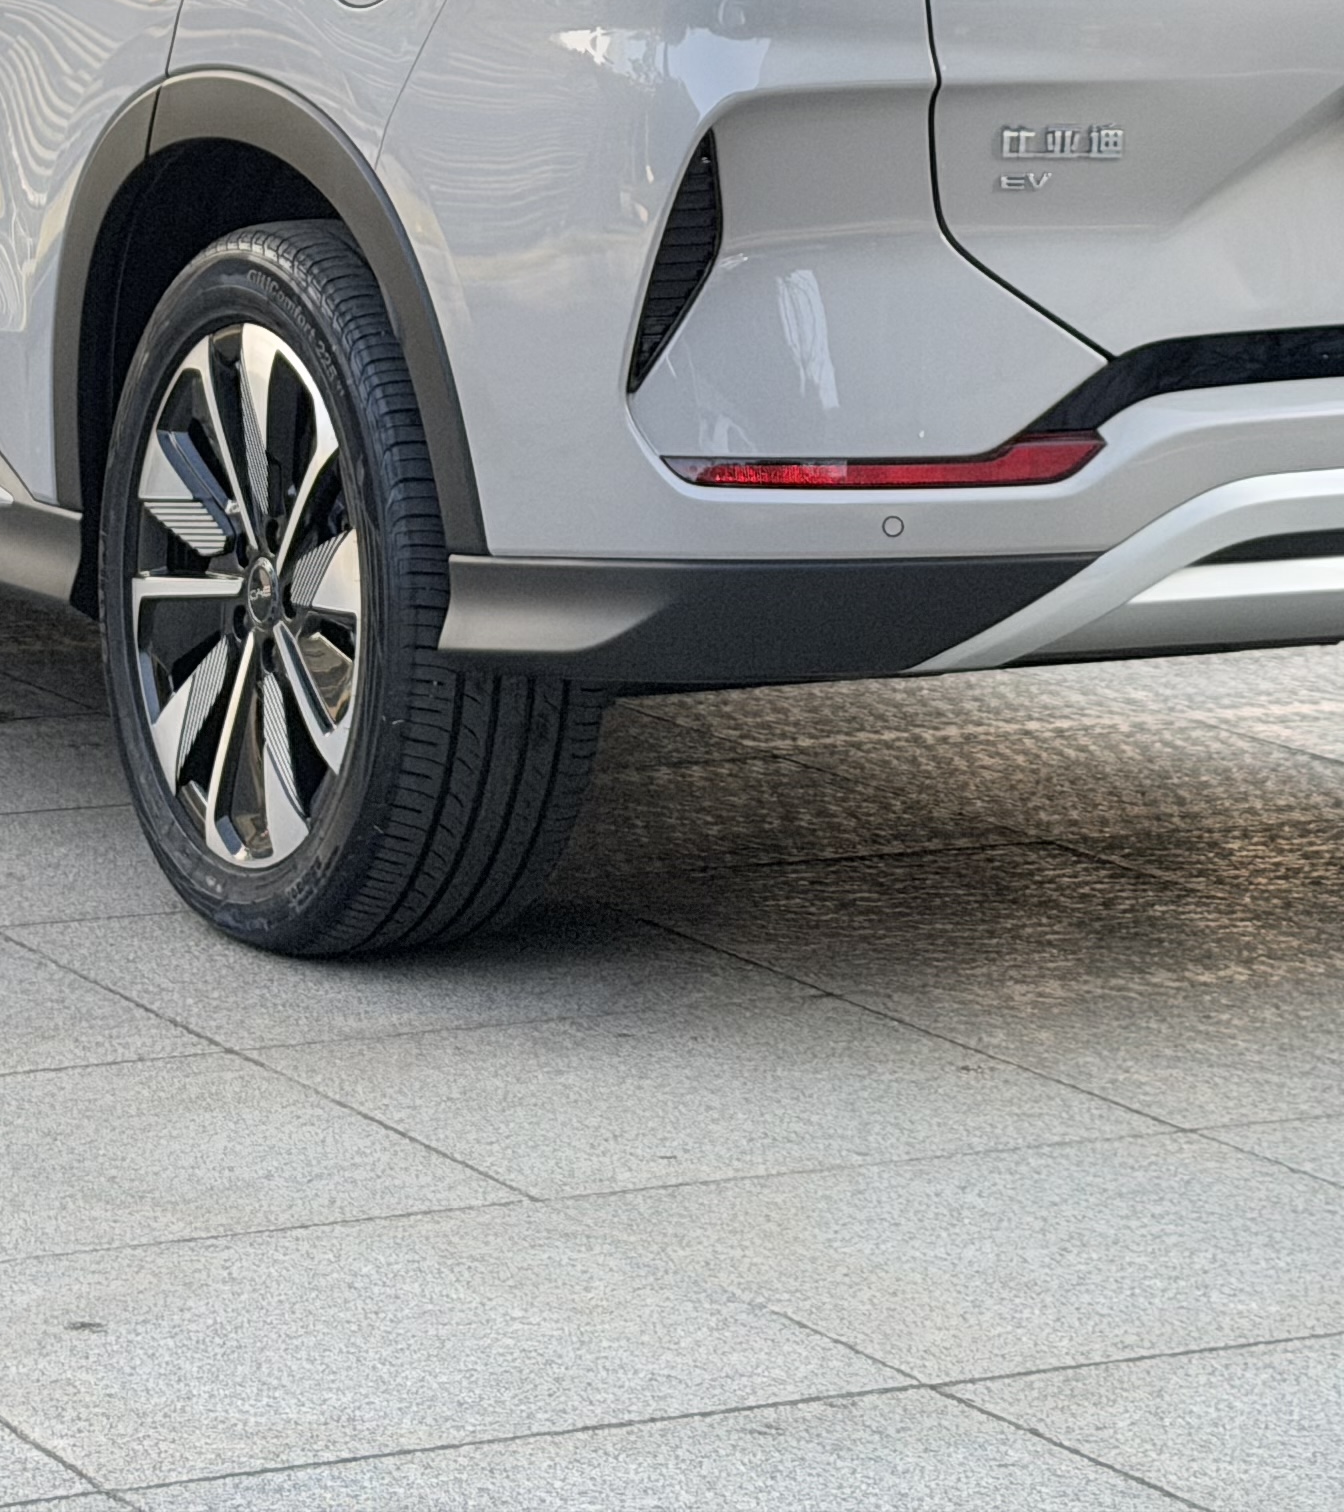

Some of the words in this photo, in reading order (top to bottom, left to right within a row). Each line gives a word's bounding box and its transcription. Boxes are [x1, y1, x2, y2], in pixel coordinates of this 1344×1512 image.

[1001, 123, 1125, 160] 比亚迪
[999, 172, 1053, 190] EV
